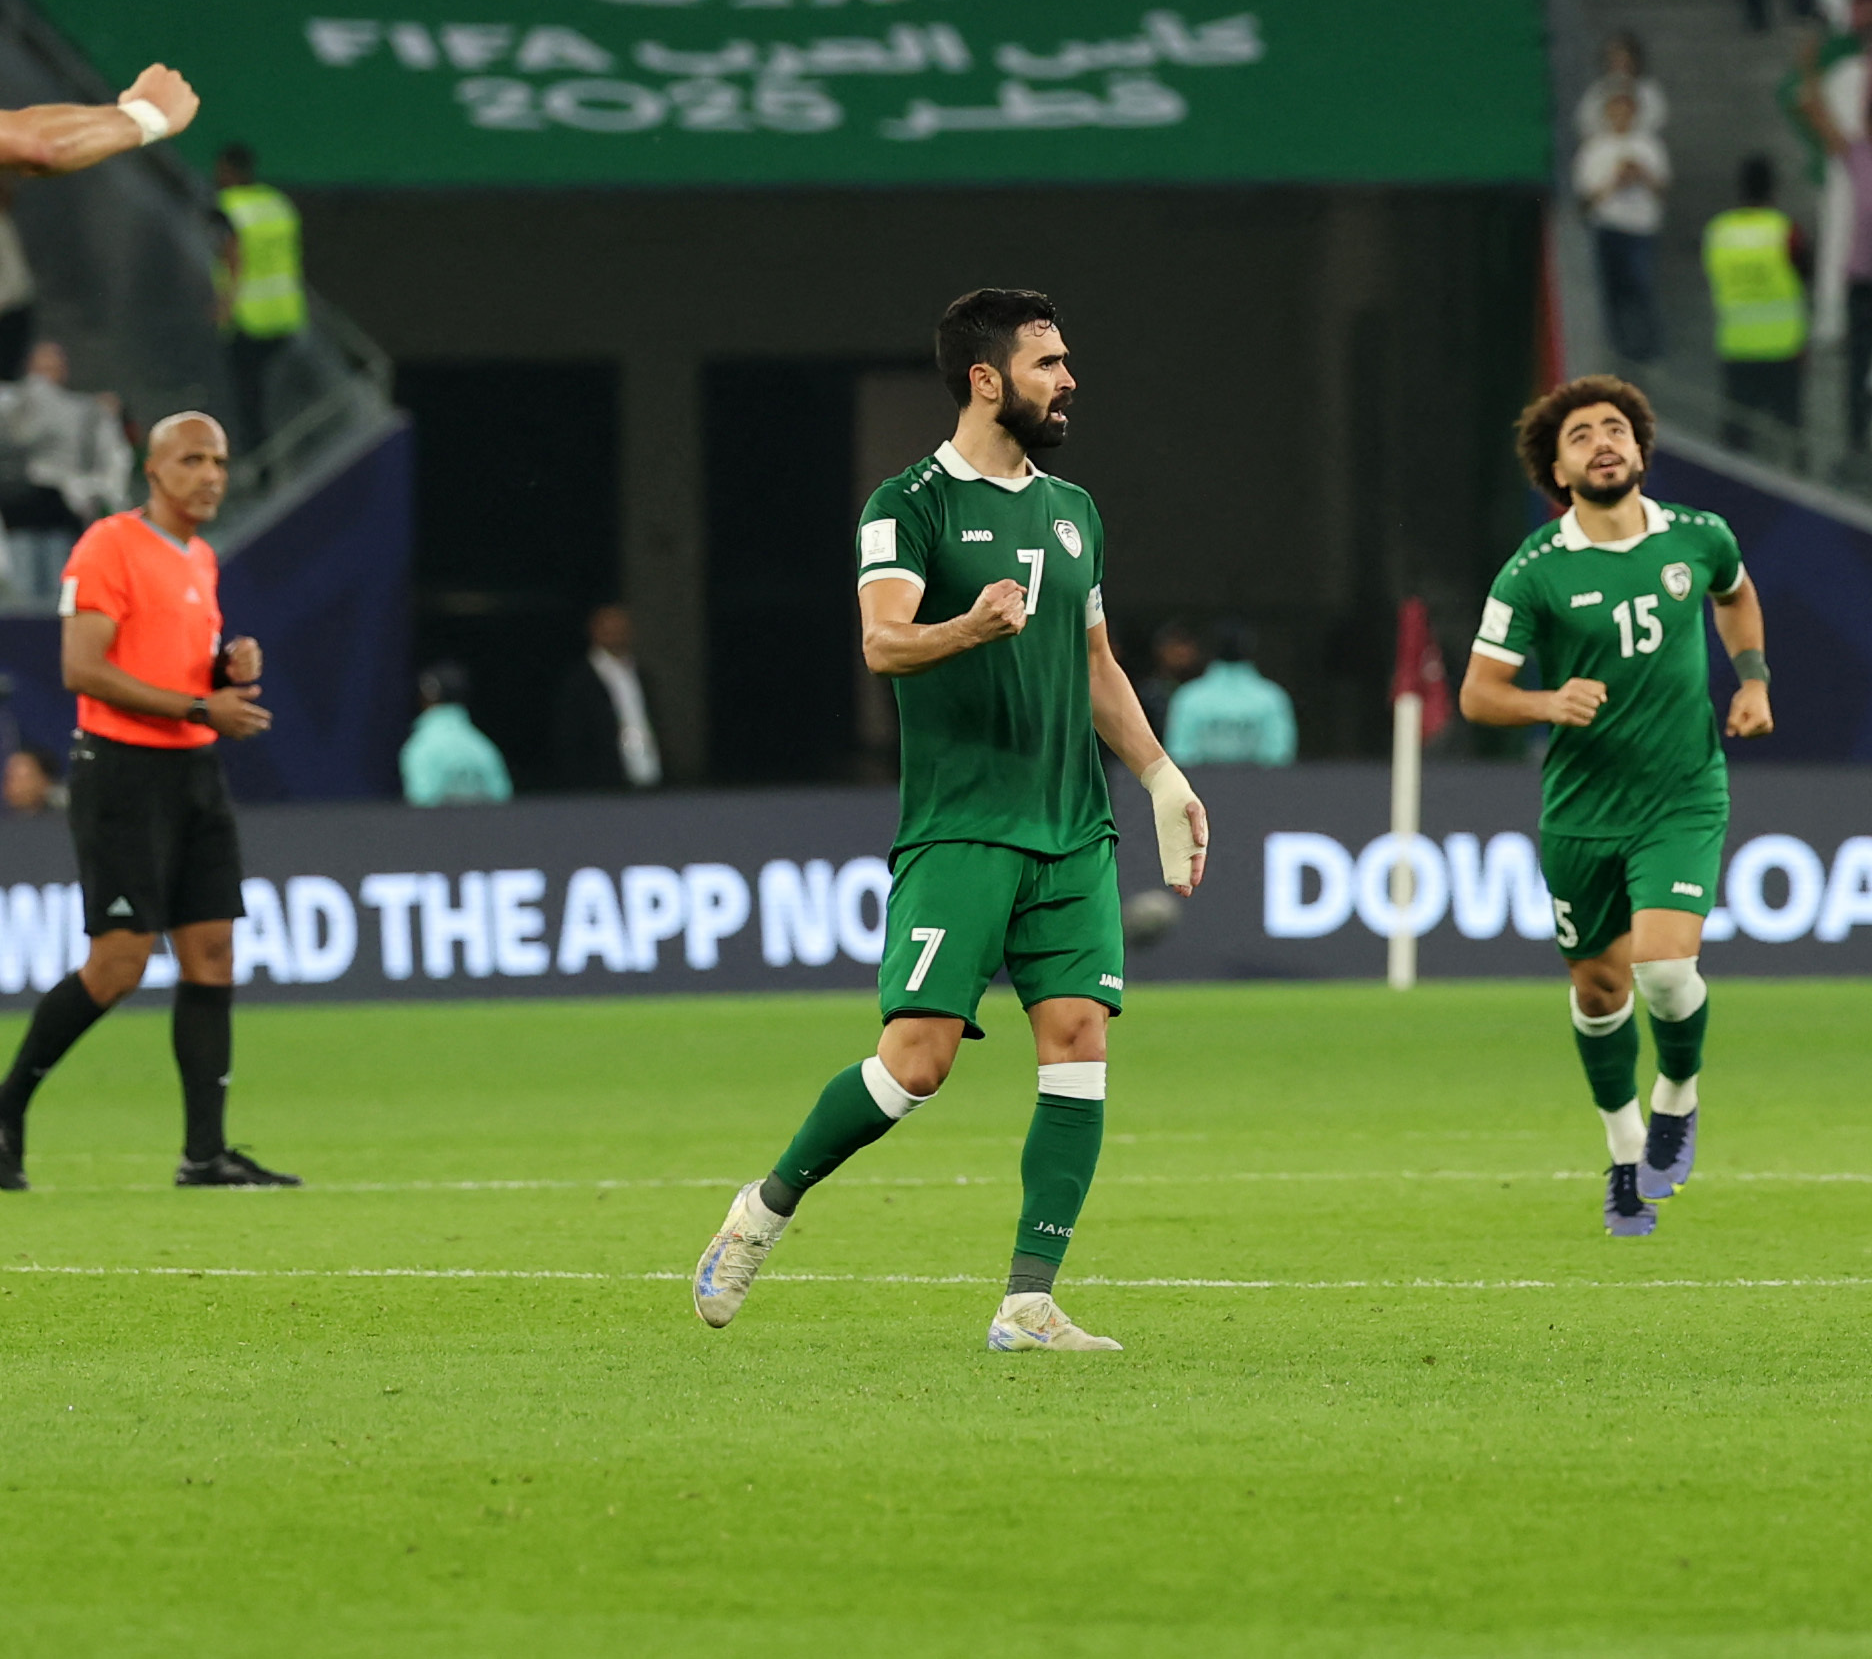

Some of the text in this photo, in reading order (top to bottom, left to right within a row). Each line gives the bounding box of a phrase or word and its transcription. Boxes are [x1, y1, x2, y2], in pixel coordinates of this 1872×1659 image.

[308, 17, 614, 73] FIFA
[456, 77, 842, 133] 2025
[961, 529, 994, 543] JAKO
[1016, 548, 1045, 615] 7
[1612, 593, 1664, 659] 15
[360, 867, 550, 981] THE
[556, 862, 750, 975] APP
[758, 855, 892, 968] NO
[906, 927, 945, 991] 7
[1033, 1219, 1074, 1238] JAKO
